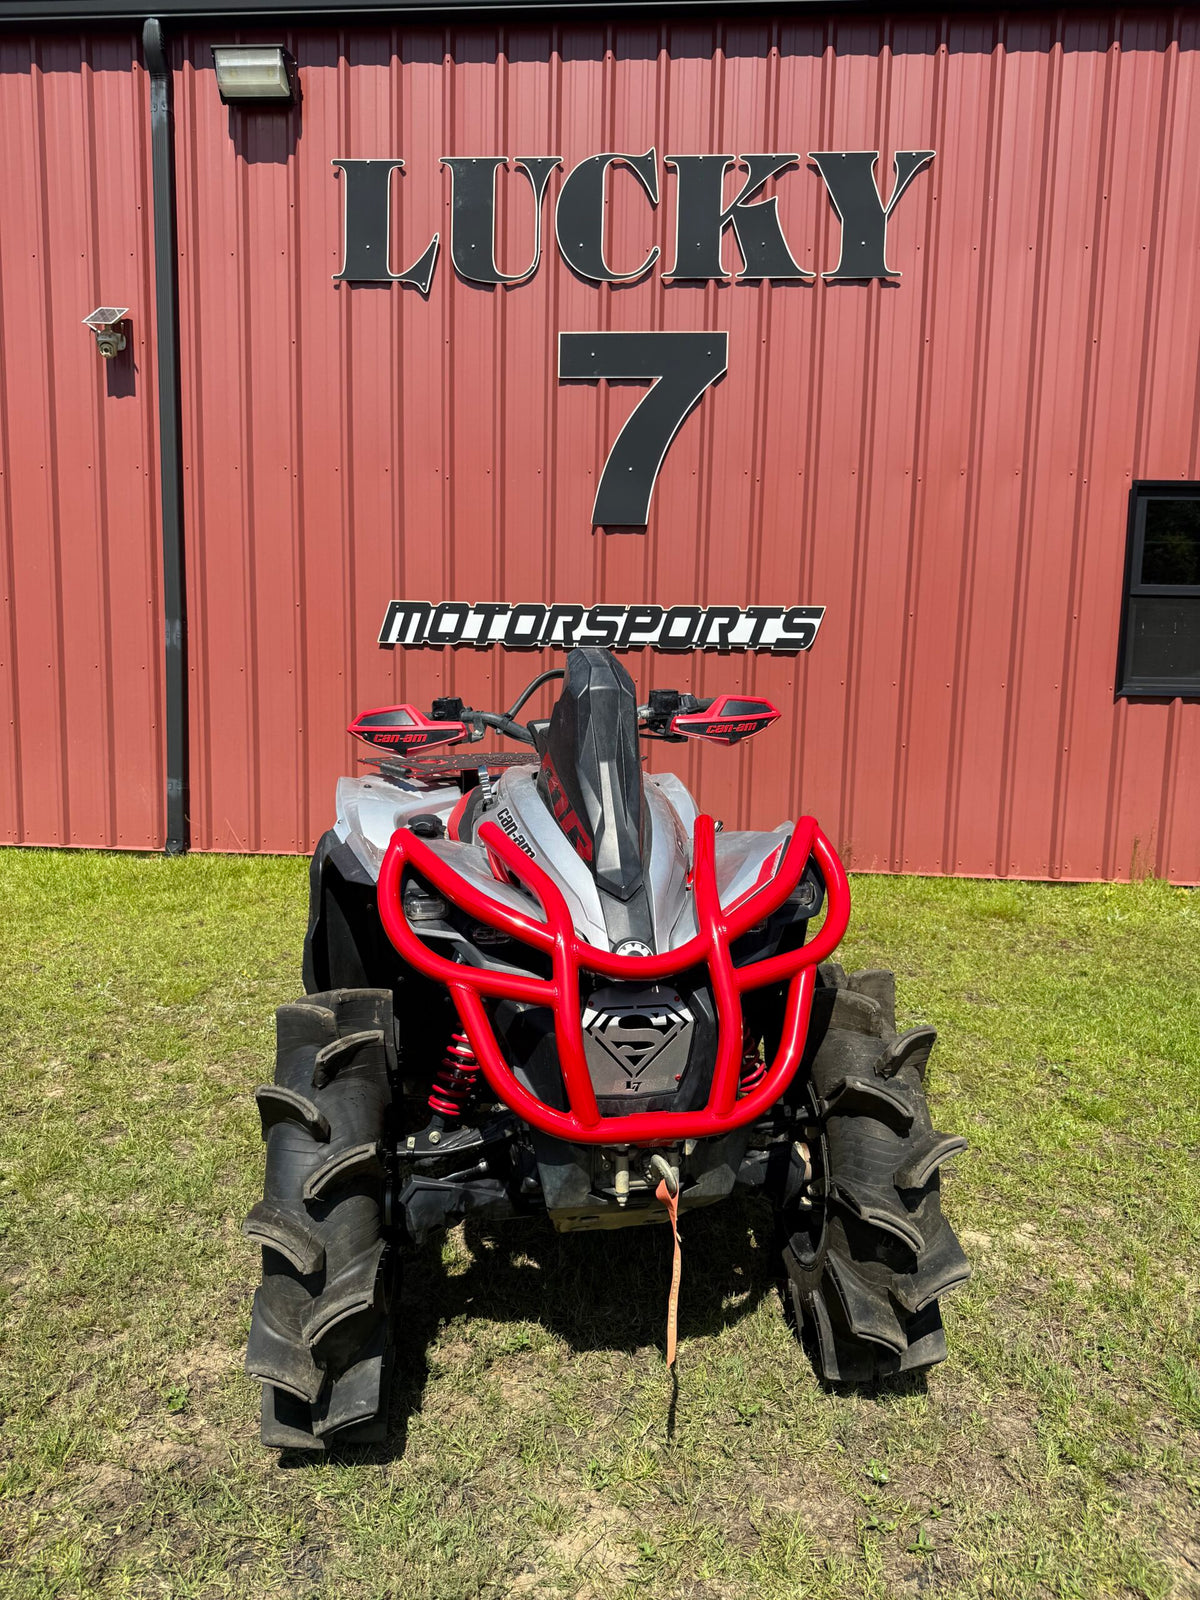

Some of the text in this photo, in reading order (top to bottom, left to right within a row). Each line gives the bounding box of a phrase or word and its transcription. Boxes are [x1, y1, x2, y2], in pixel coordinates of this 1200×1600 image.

[331, 147, 936, 293] LUCKY
[558, 331, 729, 526] 7
[378, 600, 826, 651] MOTORSPORTS
[373, 733, 428, 743] can-am
[705, 722, 757, 734] can-am
